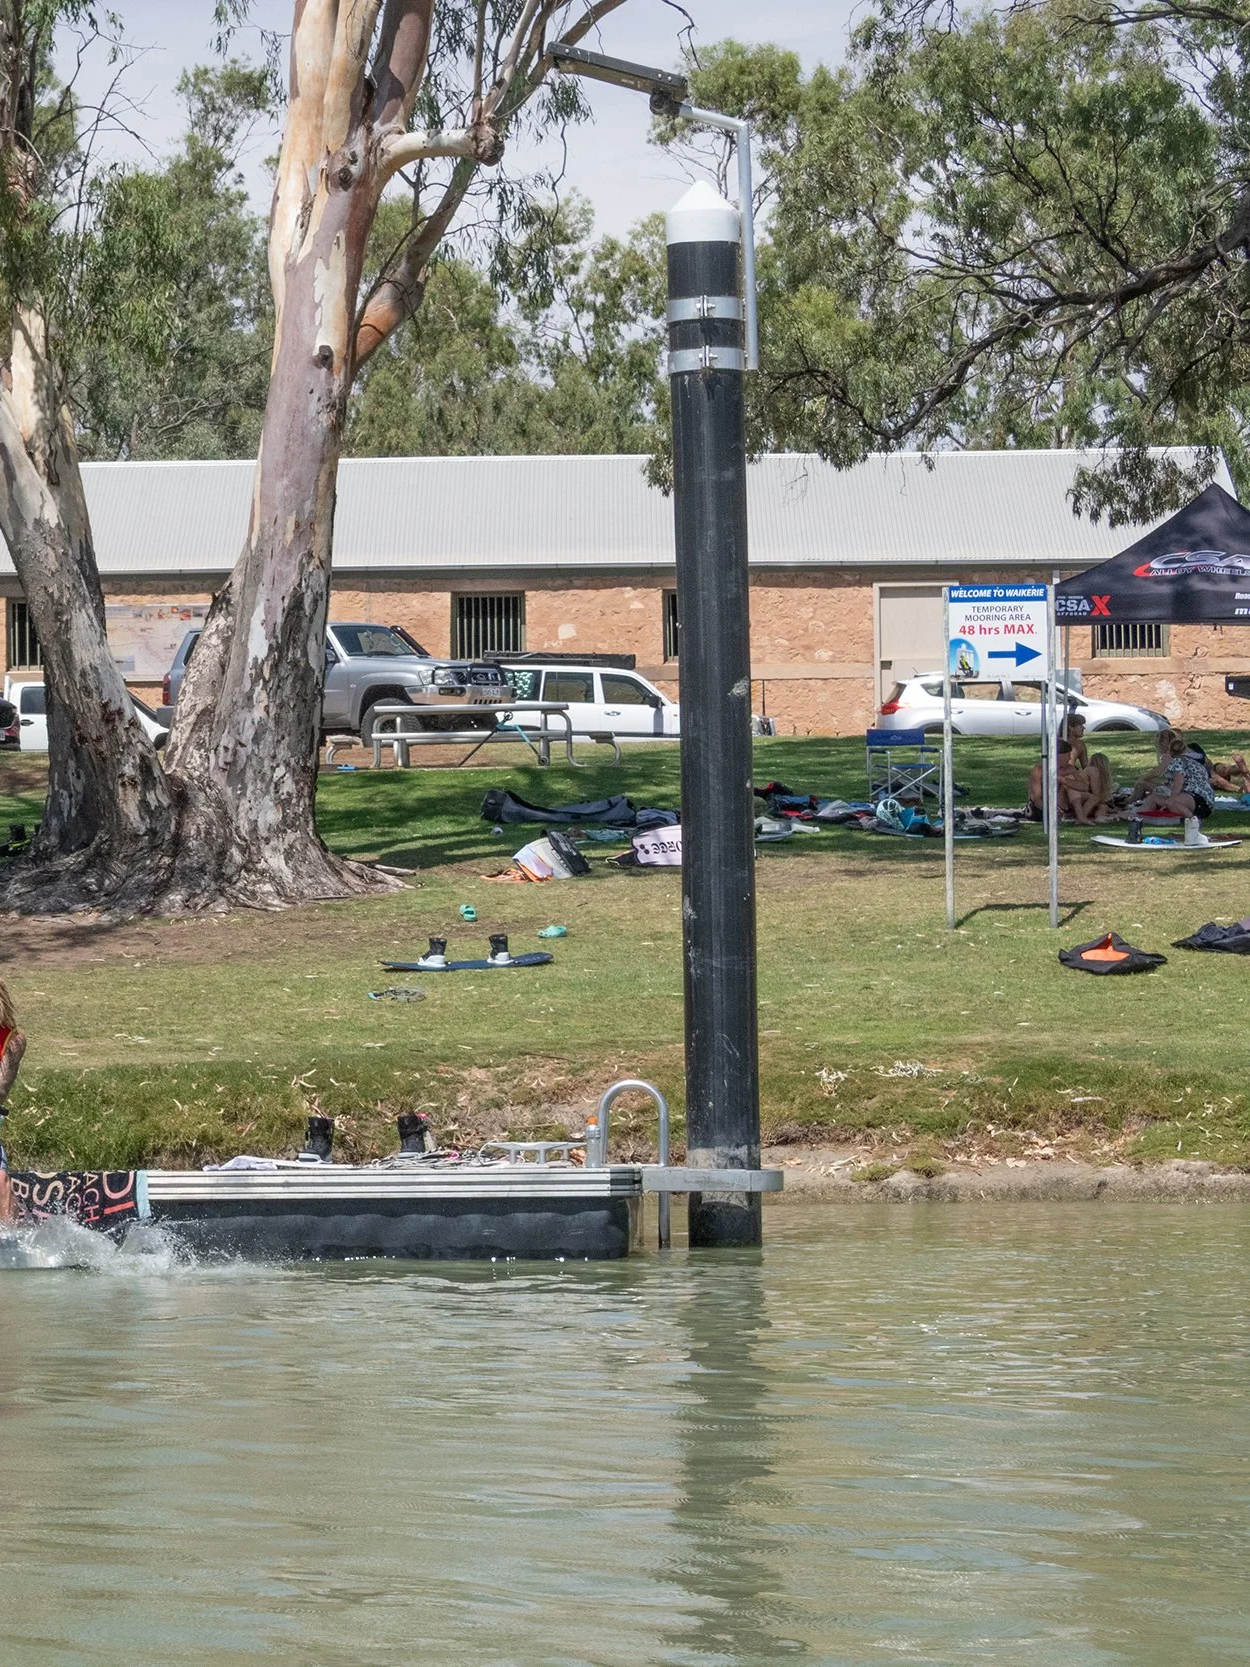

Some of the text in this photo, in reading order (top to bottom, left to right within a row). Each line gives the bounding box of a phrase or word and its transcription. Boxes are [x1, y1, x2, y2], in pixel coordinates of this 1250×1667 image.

[1150, 550, 1250, 570] CSA
[1150, 565, 1250, 576] ALLOY WHEELS
[951, 588, 1045, 598] WELCOME TO WAIKERIE
[972, 605, 1024, 613] TEMPORARY
[1055, 599, 1091, 611] CSA
[964, 613, 1031, 622] MOORING AREA
[958, 625, 976, 635] 48
[978, 624, 1000, 635] hrs
